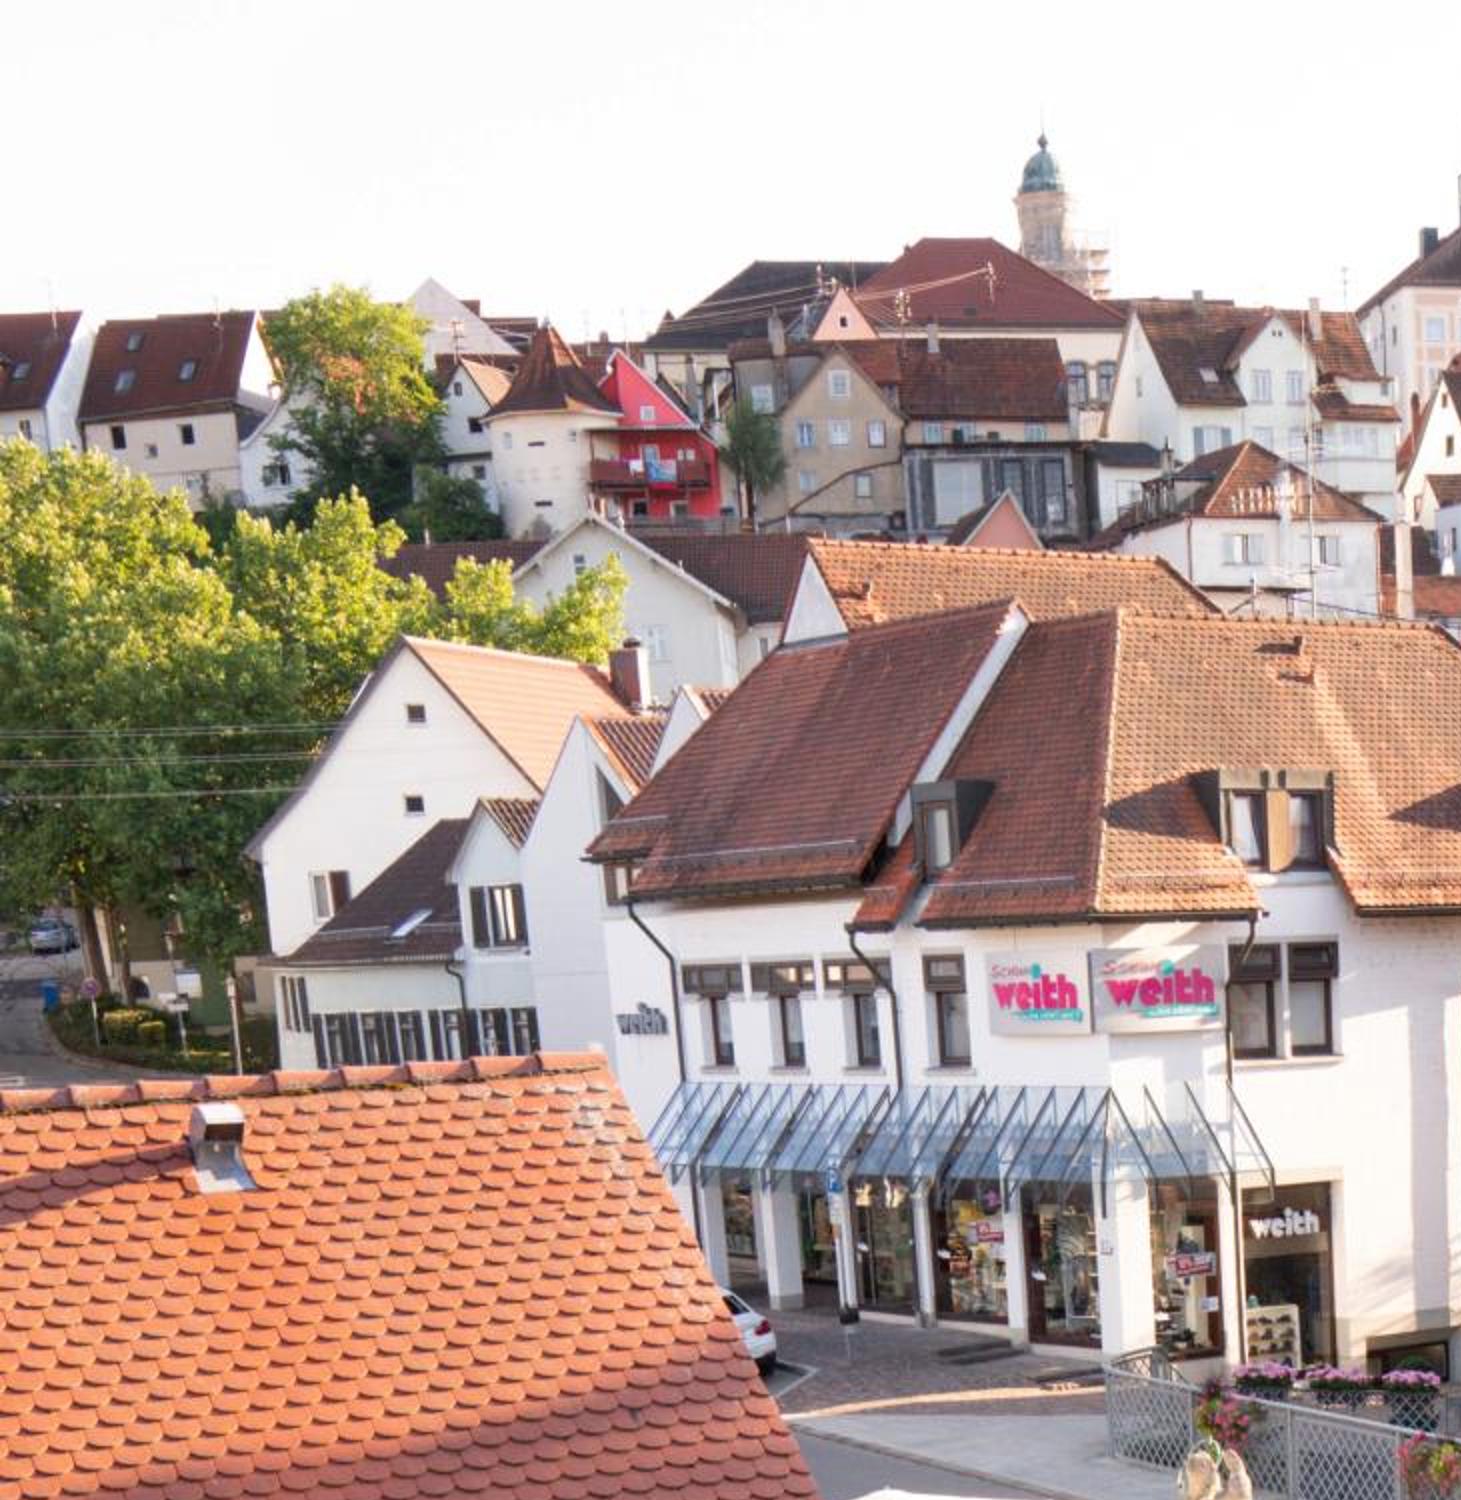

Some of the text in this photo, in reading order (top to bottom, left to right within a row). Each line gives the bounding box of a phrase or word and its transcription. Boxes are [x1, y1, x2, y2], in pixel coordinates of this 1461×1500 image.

[992, 962, 1079, 1010] weith
[1104, 959, 1215, 1006] weith
[1248, 1206, 1320, 1240] weith
